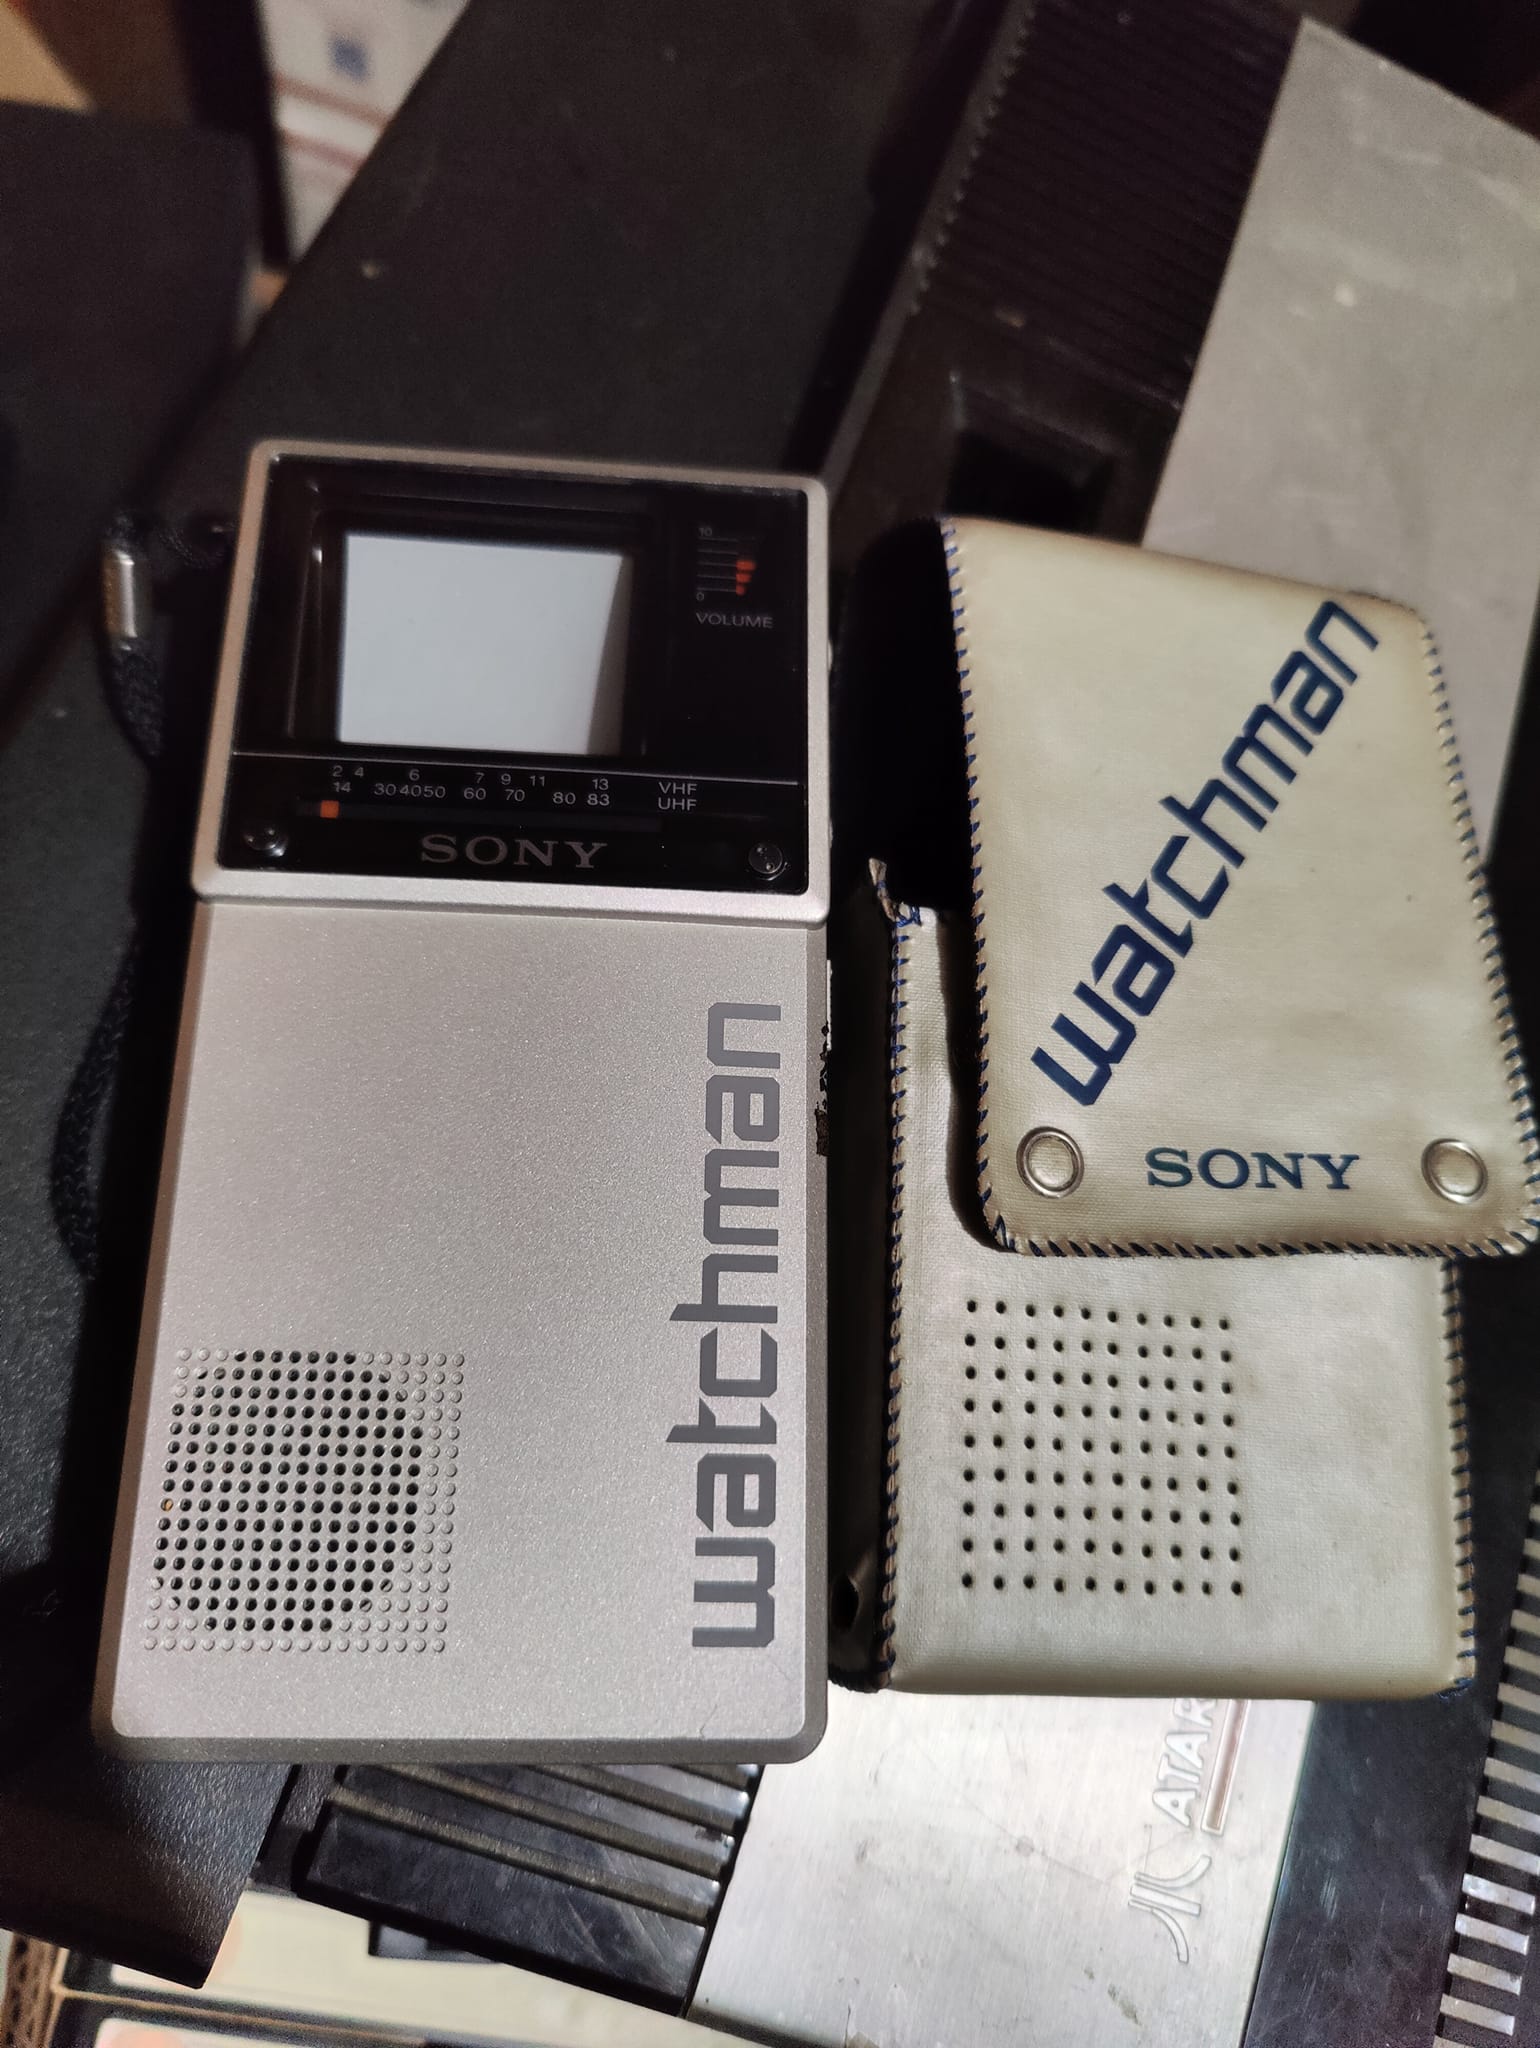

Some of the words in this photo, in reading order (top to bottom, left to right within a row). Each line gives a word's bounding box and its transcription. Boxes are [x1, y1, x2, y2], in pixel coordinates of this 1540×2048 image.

[698, 527, 713, 537] 10
[696, 591, 705, 601] 0
[695, 611, 774, 629] VOLUME
[331, 765, 344, 778] 2
[353, 766, 365, 777] 4
[408, 768, 421, 781] 6
[474, 772, 486, 784] 7
[500, 773, 512, 786] 9
[529, 775, 546, 787] 11
[591, 778, 610, 791] 13
[657, 781, 698, 796] VHF
[332, 781, 353, 793] 14
[373, 783, 397, 796] 30
[463, 787, 487, 800] 60
[504, 789, 526, 802] 70
[552, 791, 576, 805] 80
[587, 793, 610, 806] 83
[657, 797, 697, 812] UHF
[421, 834, 608, 868] SONY
[1030, 600, 1379, 1106] watchman
[1144, 1146, 1360, 1191] SONY
[665, 1001, 782, 1648] watchman
[1152, 1698, 1217, 1827] ATAR
